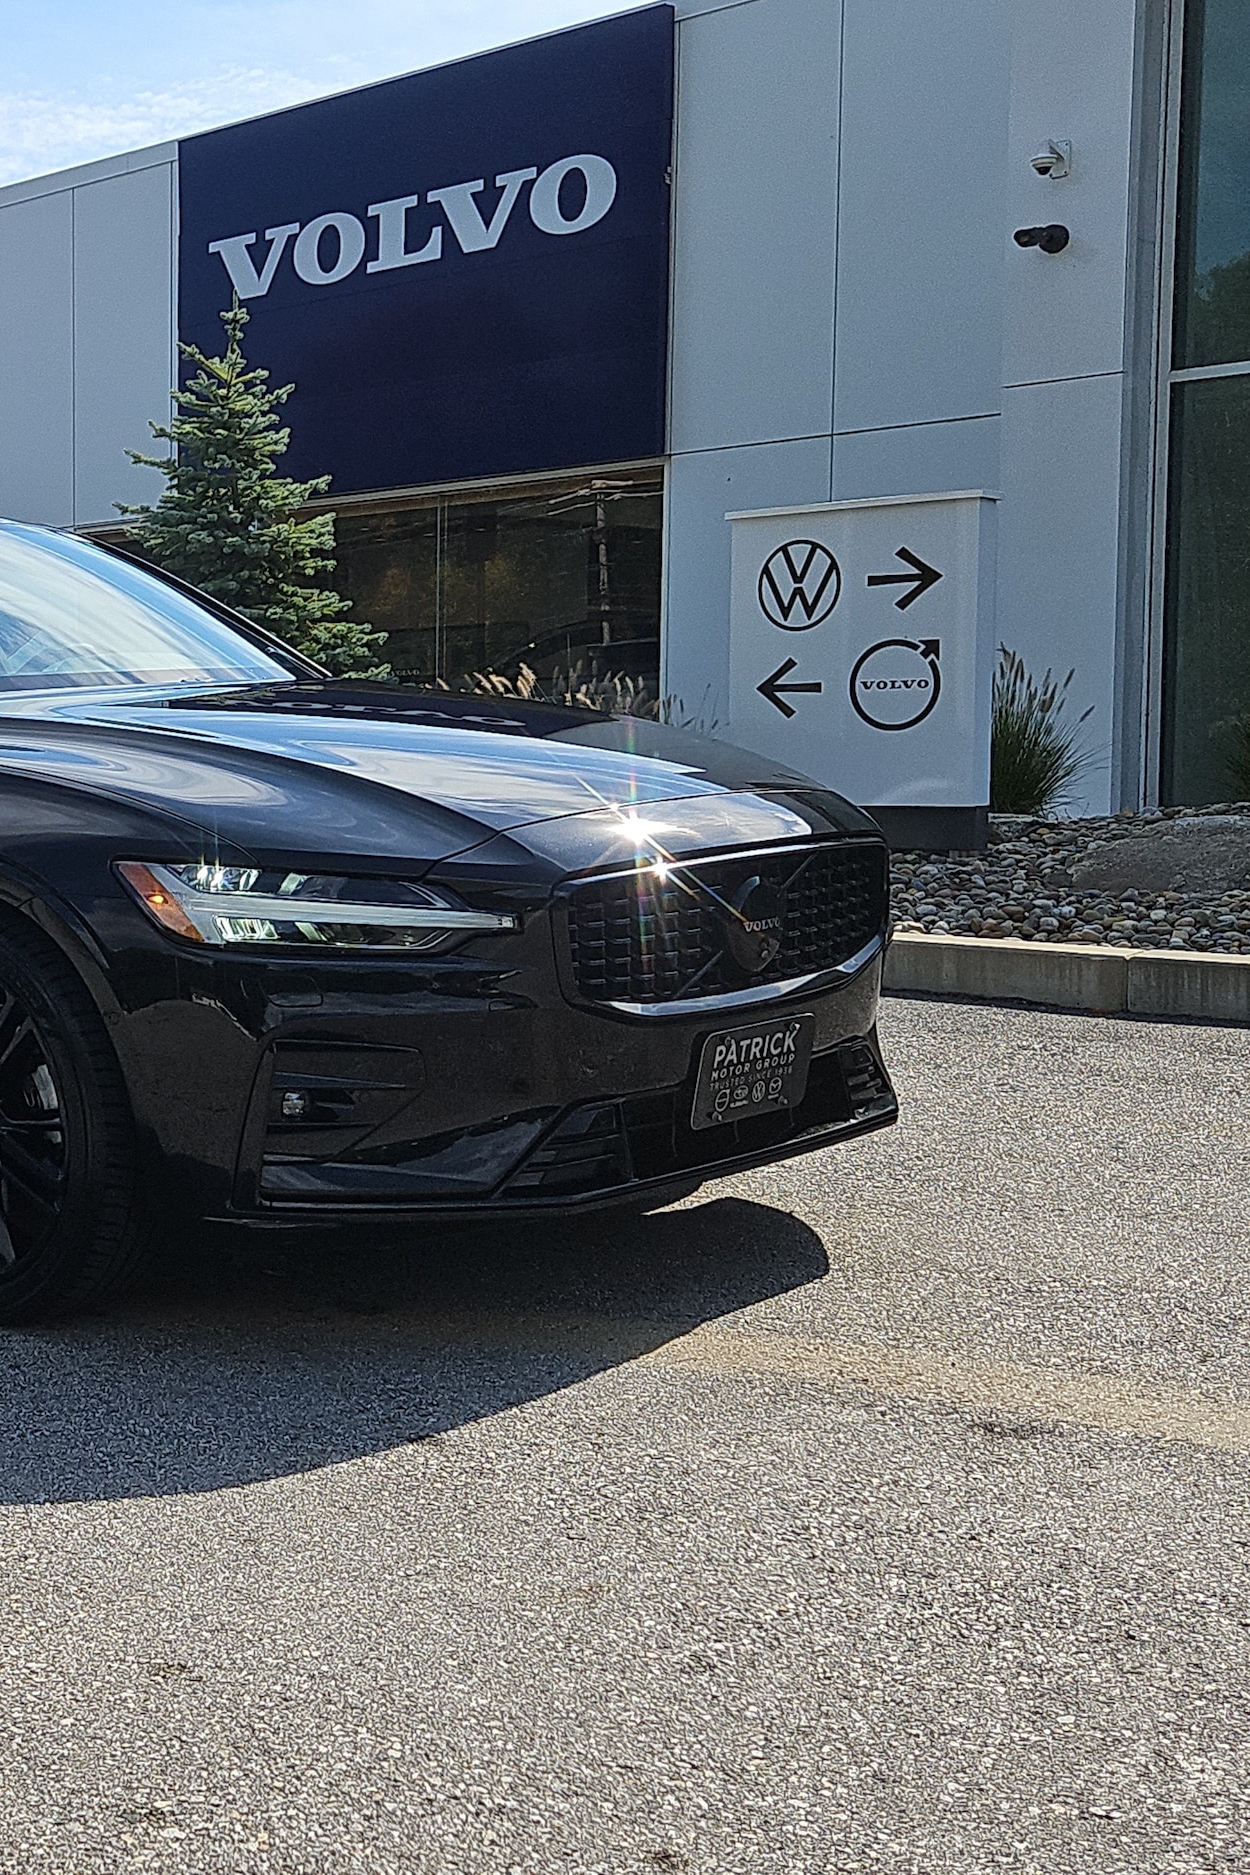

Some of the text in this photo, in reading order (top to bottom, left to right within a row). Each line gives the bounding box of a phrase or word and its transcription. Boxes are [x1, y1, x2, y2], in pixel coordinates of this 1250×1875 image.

[208, 153, 618, 300] VOLVO
[860, 679, 930, 690] VOLVO
[743, 916, 781, 933] VOLVO
[713, 1029, 798, 1069] PATRICK
[711, 1053, 796, 1081] MOTOR GROUP
[710, 1076, 746, 1091] TRUSTED
